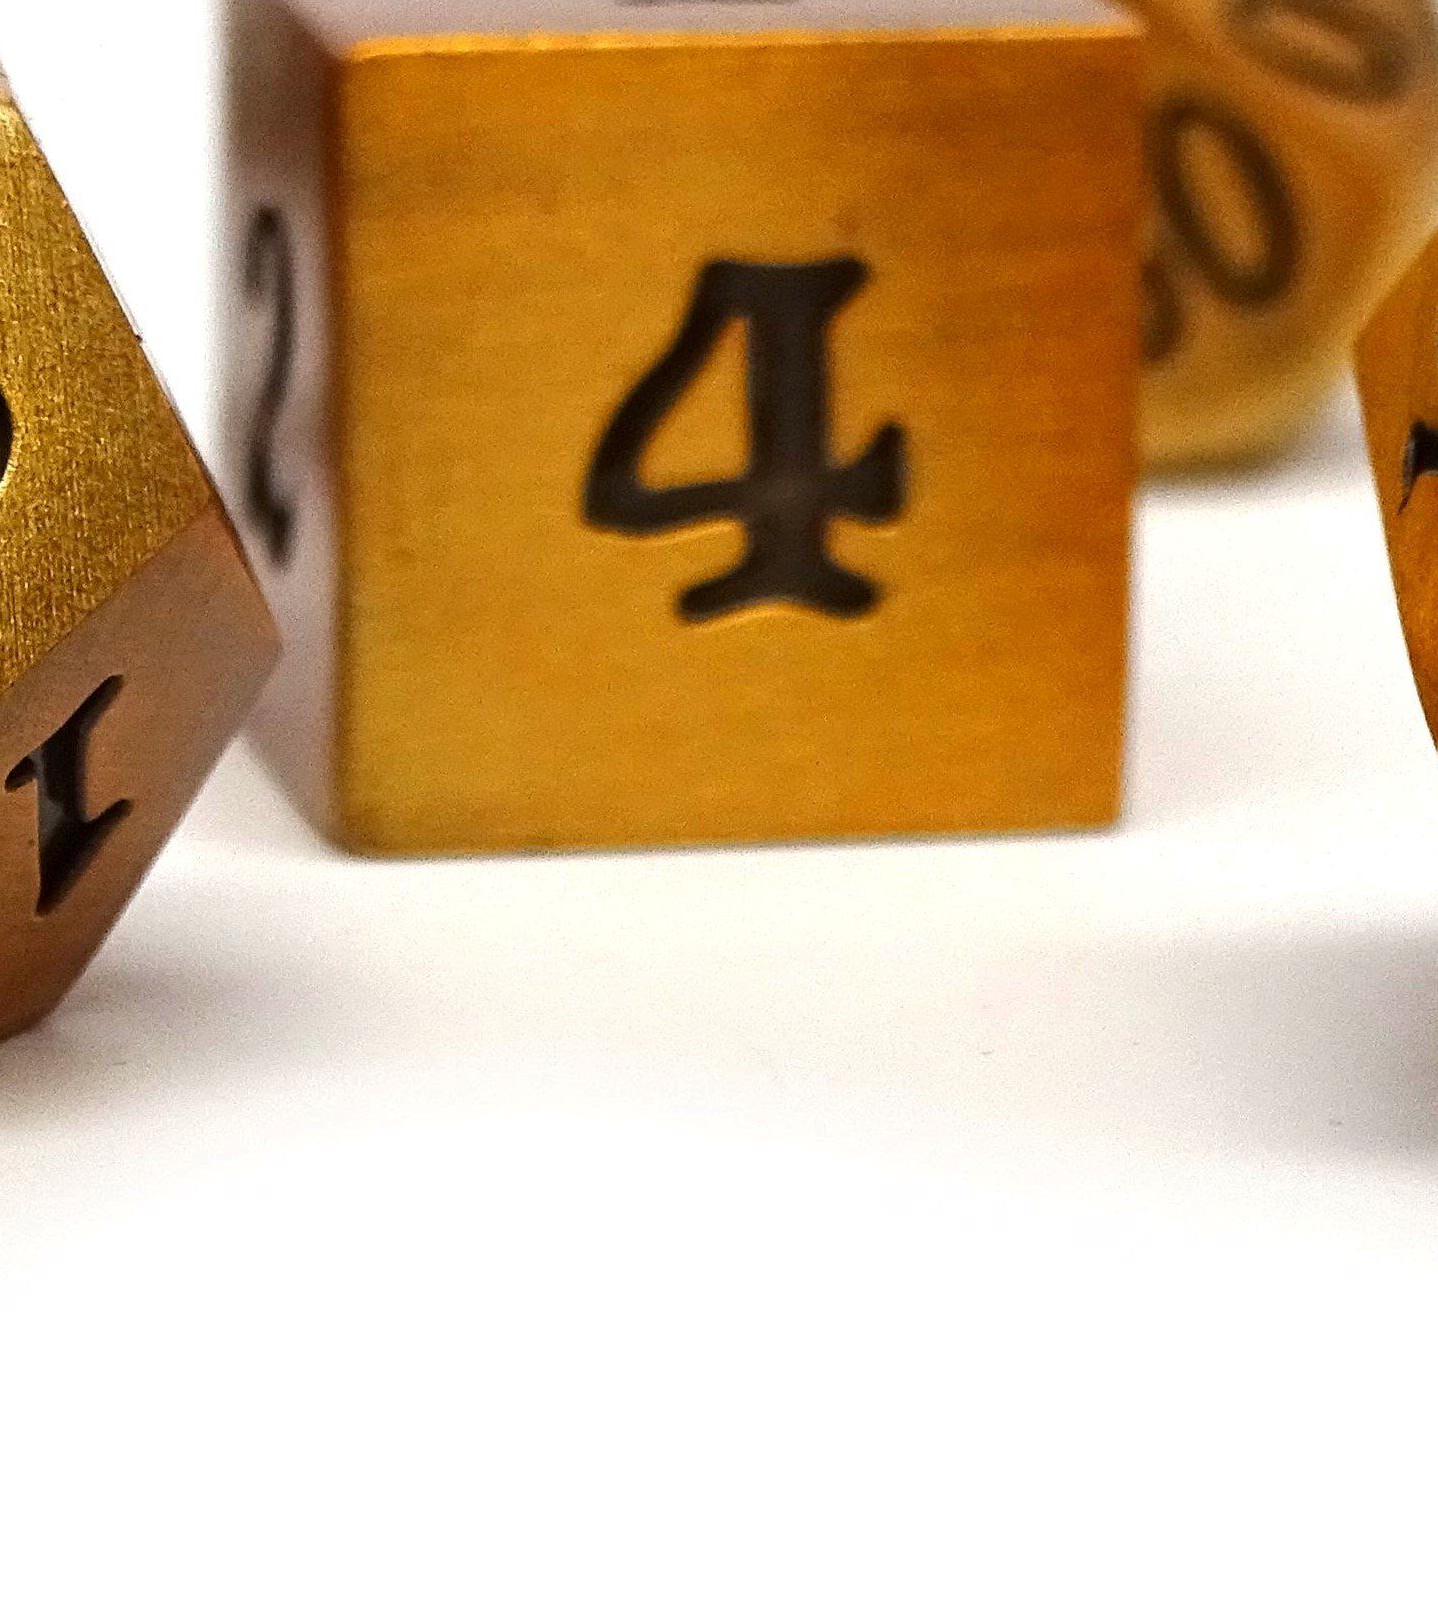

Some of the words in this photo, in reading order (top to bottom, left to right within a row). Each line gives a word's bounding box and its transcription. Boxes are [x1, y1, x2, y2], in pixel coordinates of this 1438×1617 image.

[243, 201, 298, 573] 2
[581, 253, 909, 625] 4
[5, 674, 131, 916] 1
